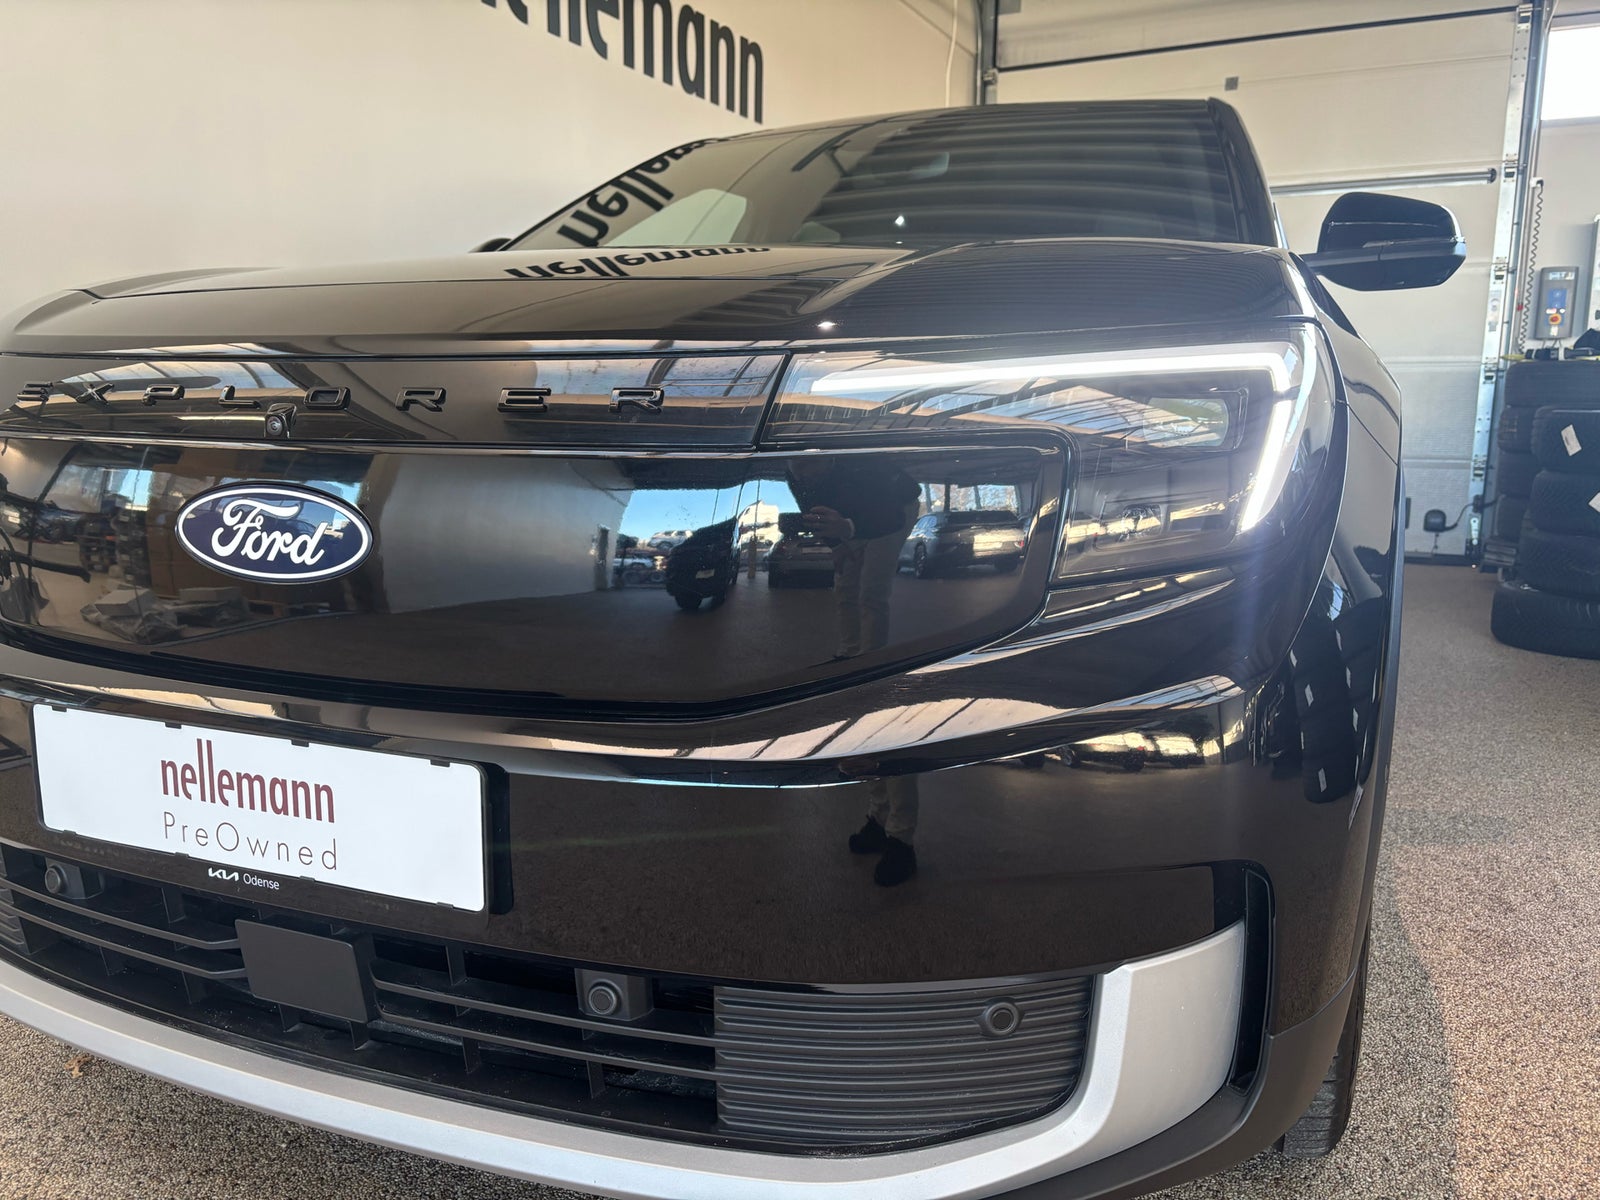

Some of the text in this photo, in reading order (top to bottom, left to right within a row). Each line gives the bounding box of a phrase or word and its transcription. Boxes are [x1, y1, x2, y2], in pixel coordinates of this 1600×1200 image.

[481, 0, 762, 124] emann
[16, 382, 666, 413] EXPLORER
[210, 499, 329, 566] Ford
[160, 738, 336, 824] nellemann
[242, 873, 280, 891] Odense
